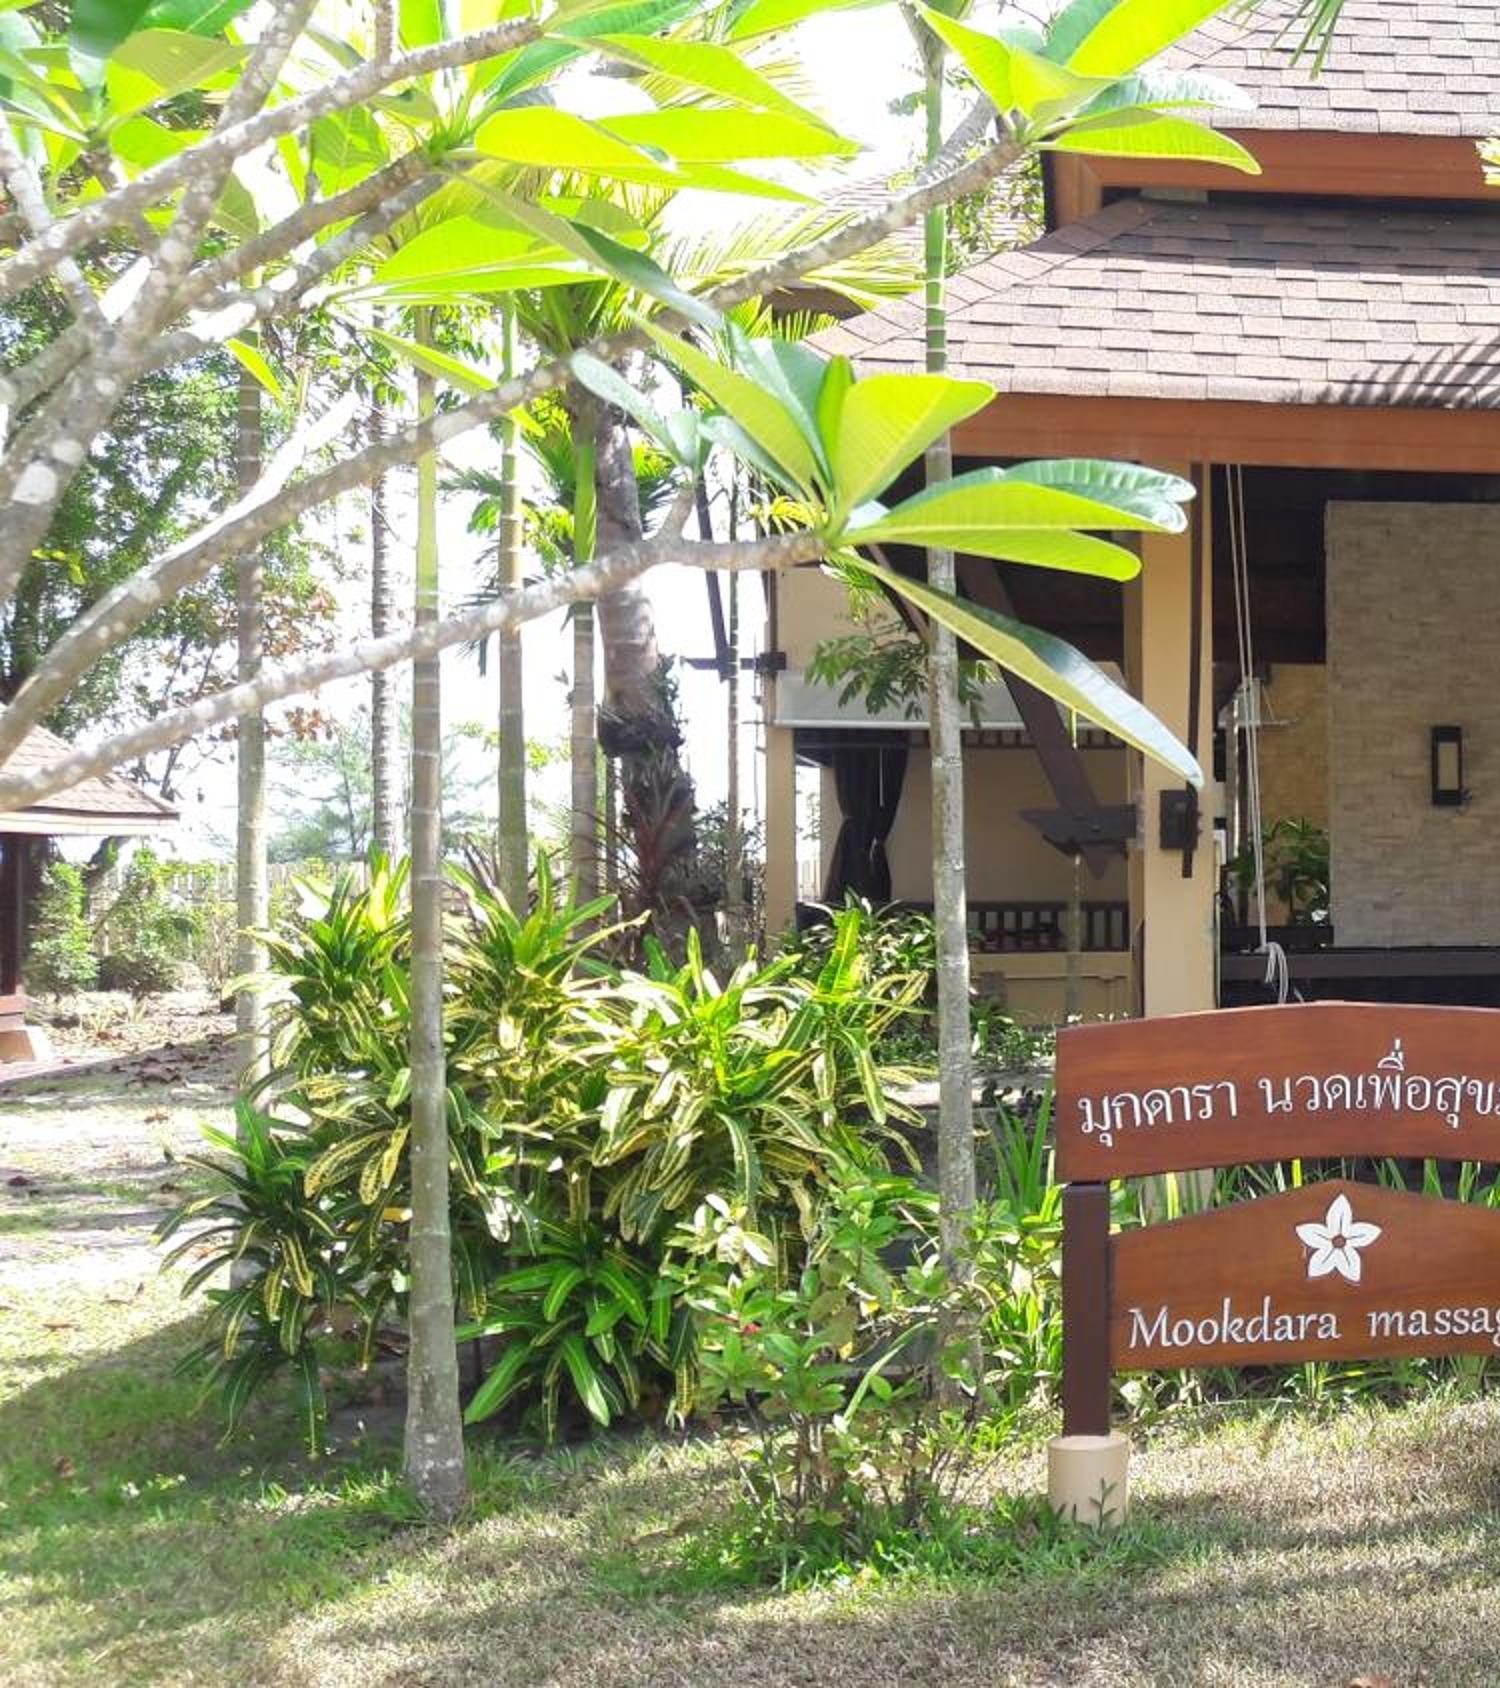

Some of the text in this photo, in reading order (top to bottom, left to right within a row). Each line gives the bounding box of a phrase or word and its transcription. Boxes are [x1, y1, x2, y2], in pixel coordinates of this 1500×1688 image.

[1077, 1081, 1238, 1148] มุกดารา
[1128, 1295, 1342, 1350] Mookdara
